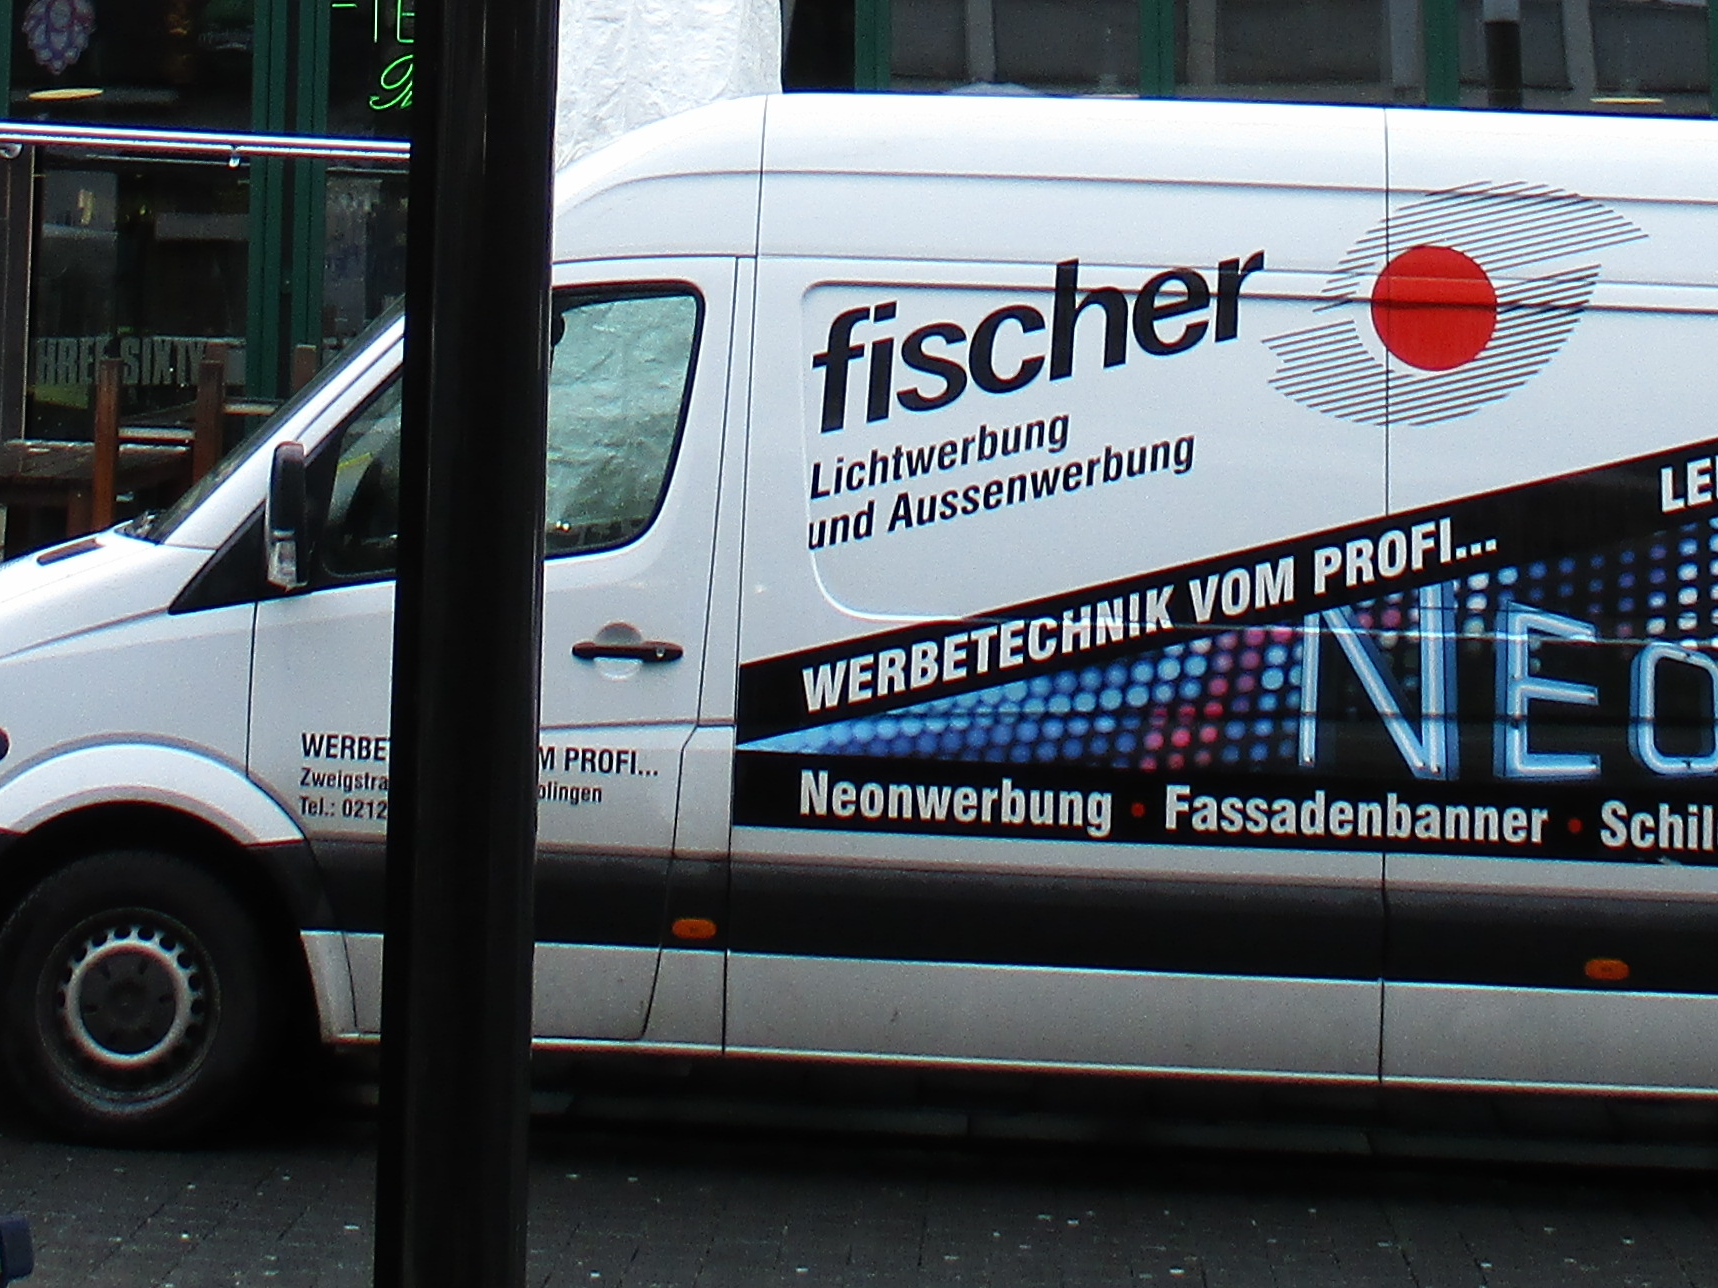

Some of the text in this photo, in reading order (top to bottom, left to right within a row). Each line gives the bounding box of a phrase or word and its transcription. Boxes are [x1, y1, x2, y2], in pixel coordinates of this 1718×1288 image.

[812, 250, 1265, 434] fischer
[808, 434, 1196, 551] und Aussenwerbung
[810, 413, 1070, 500] Lichtwerbung
[802, 516, 1498, 715] WERBETECHNIK VOM PROFI...
[300, 767, 389, 793] Zweigstra
[564, 746, 659, 776] PROFI...
[299, 795, 335, 817] Tel.:
[799, 770, 1112, 837] Neonwerbung
[1164, 784, 1548, 844] Fassadenbanner
